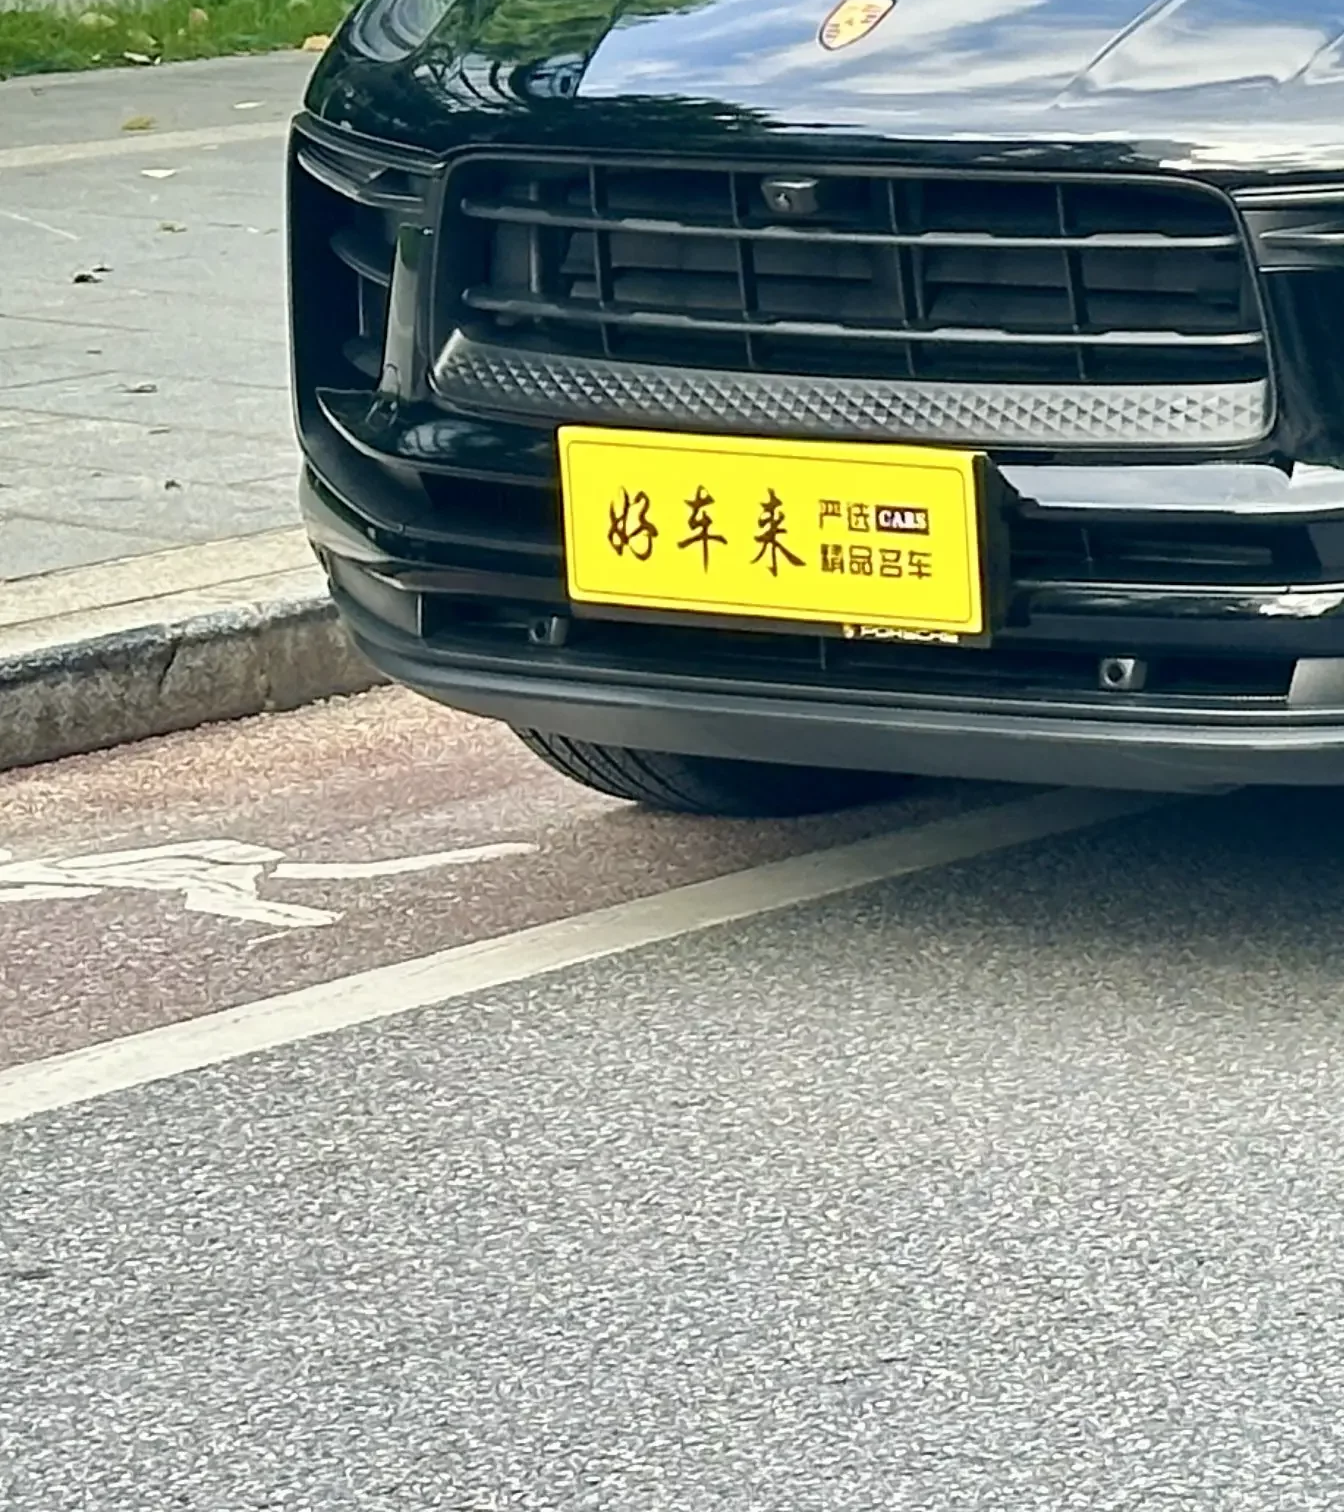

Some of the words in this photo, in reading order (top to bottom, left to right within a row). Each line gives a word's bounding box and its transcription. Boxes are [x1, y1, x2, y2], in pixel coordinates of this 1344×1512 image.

[819, 499, 870, 533] 严选
[877, 509, 928, 530] CARS
[820, 543, 932, 579] 精品名车
